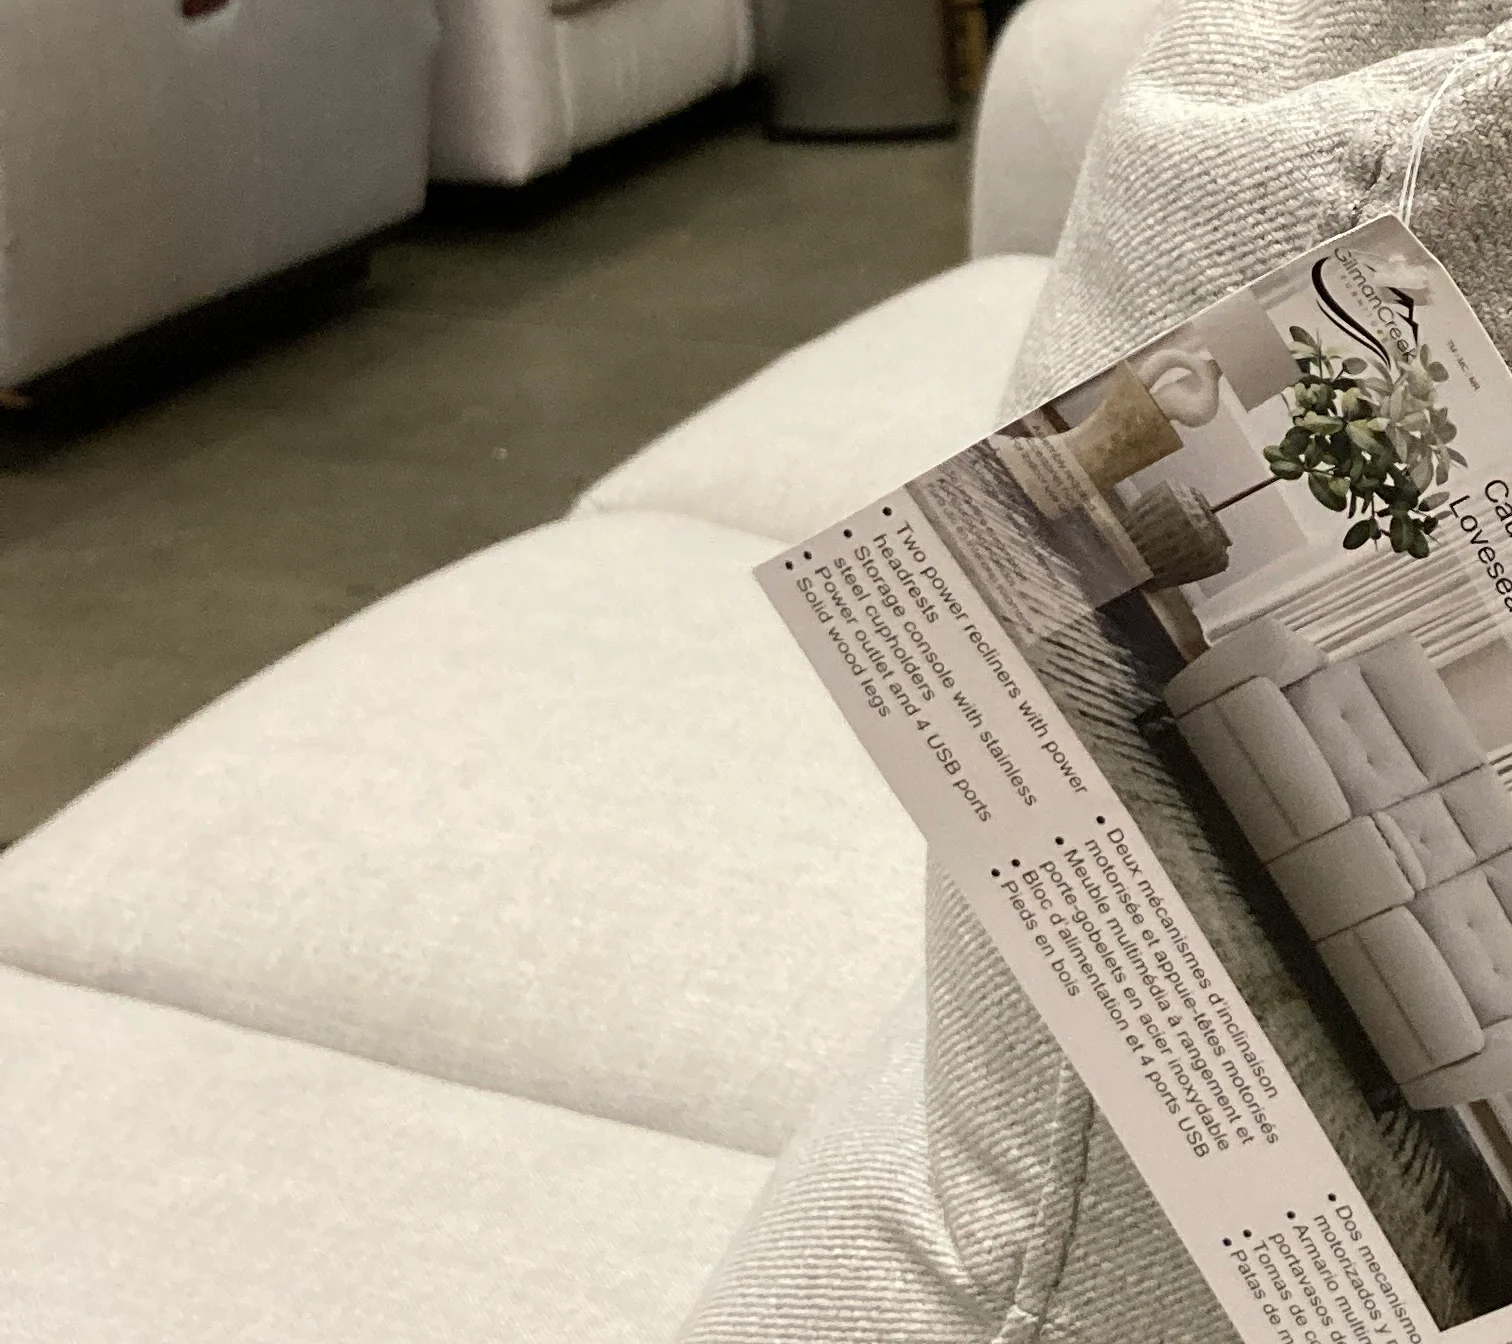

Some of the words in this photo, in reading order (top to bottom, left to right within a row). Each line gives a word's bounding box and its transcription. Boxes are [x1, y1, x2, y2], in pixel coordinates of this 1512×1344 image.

[795, 575, 835, 625] Solid
[827, 624, 868, 677] wood
[858, 677, 892, 720] legs
[832, 555, 872, 603] steel
[862, 602, 938, 703] cupholders
[872, 532, 941, 624] headrests
[813, 564, 861, 626] Power
[853, 627, 896, 681] outlet
[888, 680, 922, 718] and
[925, 732, 963, 777] USB
[952, 776, 993, 824] ports
[850, 544, 909, 620] Storage
[902, 618, 958, 690] console
[952, 689, 985, 729] with
[978, 729, 1039, 808] stainless
[894, 520, 929, 565] Two
[919, 564, 969, 624] power
[962, 622, 1024, 701] recliners
[1017, 698, 1051, 739] with
[1040, 739, 1089, 796] power
[1000, 878, 1040, 932] Pieds
[1033, 932, 1056, 958] en
[1050, 956, 1082, 998] bois
[1038, 858, 1129, 986] porte-gobelets
[1122, 985, 1144, 1011] en
[1138, 1011, 1175, 1057] acier
[1165, 1057, 1232, 1153] inoxydable
[1063, 847, 1113, 916] Meuble
[1105, 915, 1173, 1013] multimédia
[1174, 1029, 1243, 1126] rangement
[1234, 1124, 1255, 1146] et
[1083, 837, 1147, 927] motorisée
[1140, 927, 1161, 949] et
[1151, 948, 1228, 1059] appuie-têtes
[1220, 1058, 1281, 1145] motorisés
[1105, 826, 1144, 878] Deux
[1136, 877, 1214, 991] mécanismes
[1206, 990, 1281, 1100] d'inclinaison
[1021, 868, 1055, 912] Bloc
[1048, 911, 1131, 1032] d'alimentation
[1124, 1032, 1146, 1054] et
[1144, 1068, 1183, 1116] ports
[1176, 1115, 1211, 1159] USB
[1229, 1248, 1269, 1301] Patas
[1261, 1301, 1284, 1327] de
[1251, 1239, 1295, 1302] Tomas
[1287, 1302, 1310, 1328] de
[1267, 1230, 1336, 1328] portavasos
[1291, 1222, 1342, 1293] Armario
[1313, 1212, 1384, 1322] motorizados
[1334, 1203, 1365, 1243] Dos
